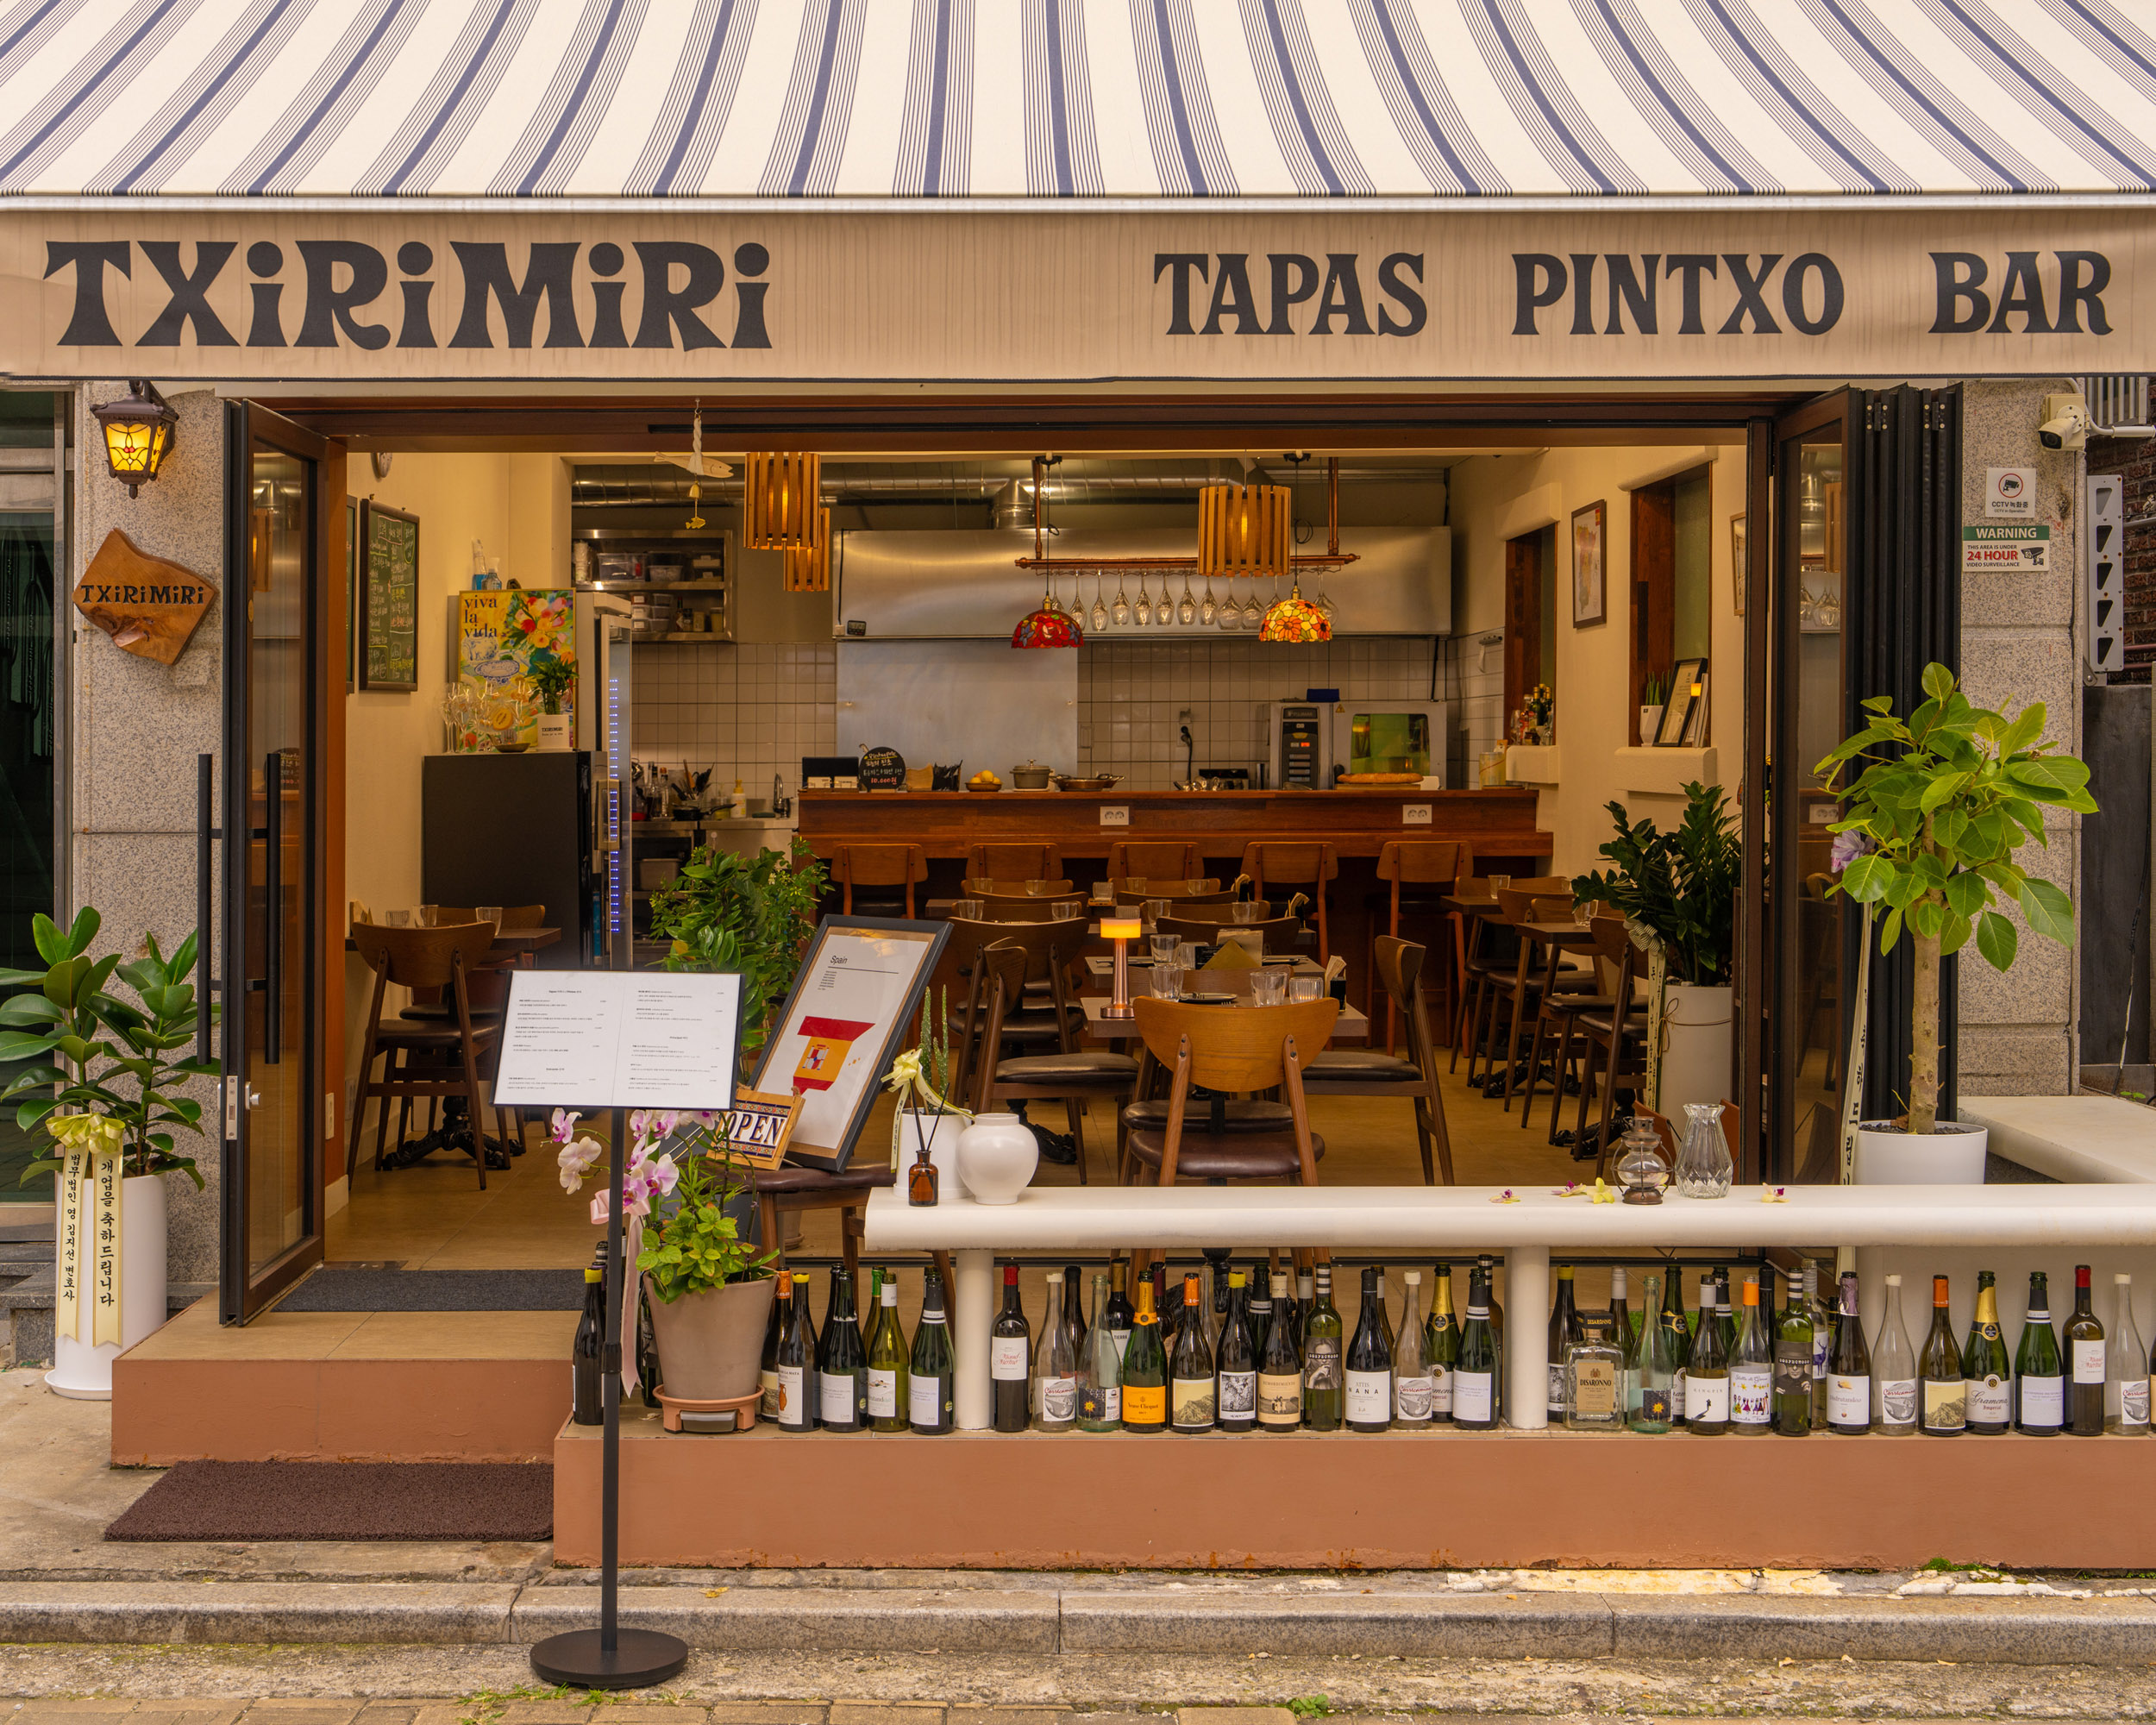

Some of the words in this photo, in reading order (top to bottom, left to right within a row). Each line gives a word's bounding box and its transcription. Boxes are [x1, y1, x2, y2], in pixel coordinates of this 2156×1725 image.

[1154, 252, 1428, 337] TAPAS
[1511, 252, 1846, 336] PINTXO
[1928, 250, 2115, 337] BAR
[1976, 527, 2037, 539] WARNING
[1967, 550, 1982, 561] 24
[1984, 550, 2018, 561] HOUR
[464, 594, 498, 609] viva
[464, 609, 478, 624] la
[464, 623, 498, 638] vida
[830, 955, 849, 965] Spain
[726, 1113, 786, 1146] OPEN
[68, 1153, 81, 1203] 법무법인
[100, 1159, 115, 1208] 개업을
[66, 1208, 76, 1220] 영
[66, 1223, 75, 1261] 김지선
[63, 1264, 75, 1302] 변호사
[1579, 1378, 1612, 1387] DISARONNO
